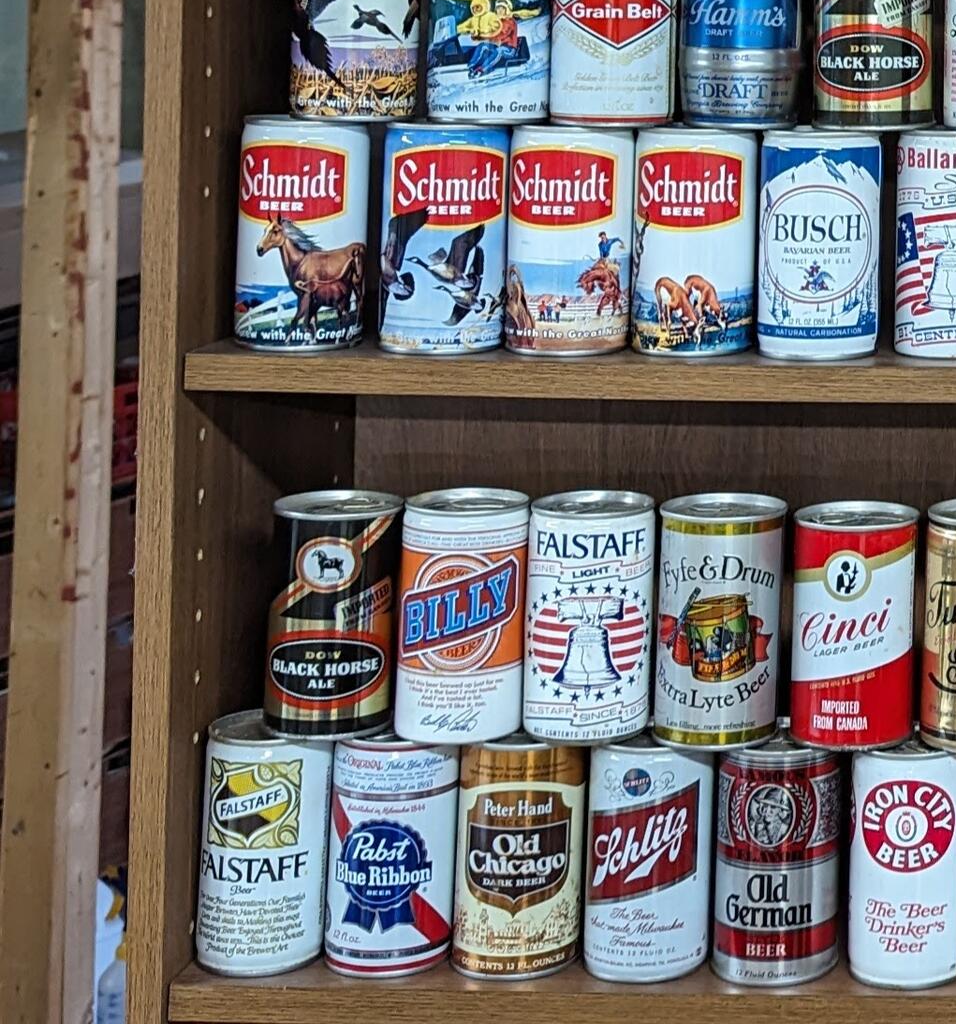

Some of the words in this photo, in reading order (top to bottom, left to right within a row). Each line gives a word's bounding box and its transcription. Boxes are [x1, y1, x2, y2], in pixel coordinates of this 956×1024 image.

[572, 3, 623, 19] Grain
[627, 3, 662, 19] Belt
[705, 28, 733, 36] DRAFT
[850, 45, 884, 53] DOW
[821, 57, 866, 69] BLACK
[869, 57, 919, 68] HORSE
[854, 72, 880, 81] ALE
[697, 83, 767, 98] DRAFT
[455, 100, 479, 112] with
[485, 100, 503, 112] the
[510, 101, 536, 112] Great
[241, 154, 340, 201] Schmidt
[398, 159, 500, 206] Schmidt
[512, 159, 609, 205] Schmidt
[640, 160, 737, 207] Schmidt
[661, 207, 705, 216] BEER
[773, 214, 861, 242] BUSCH
[537, 528, 643, 558] FALSTAFF
[572, 566, 610, 578] LIGHT
[722, 556, 775, 589] Drum
[406, 568, 512, 645] BILLY
[800, 598, 892, 651] Cinci
[273, 659, 319, 676] BLACK
[324, 658, 379, 676] HORSE
[822, 700, 859, 714] IMPORTED
[813, 716, 832, 729] FROM
[837, 716, 868, 731] CANADA
[220, 788, 281, 817] FALSTAFF
[484, 799, 515, 816] Peter
[518, 798, 552, 815] Hand
[352, 832, 410, 860] Pabst
[492, 833, 540, 854] Old
[593, 807, 687, 887] Schlitz
[876, 842, 938, 868] BEER
[201, 850, 309, 883] FALSTAFF
[336, 861, 366, 884] Blue
[369, 866, 431, 885] Ribbon
[469, 851, 565, 876] Chicago
[482, 878, 513, 887] DARK
[516, 877, 546, 887] BEER
[747, 873, 789, 903] Old
[726, 894, 812, 928] German
[866, 899, 896, 918] The
[900, 903, 948, 918] Beer
[865, 916, 945, 939] Drinker's
[746, 943, 786, 956] BEER
[879, 937, 927, 953] Beer
